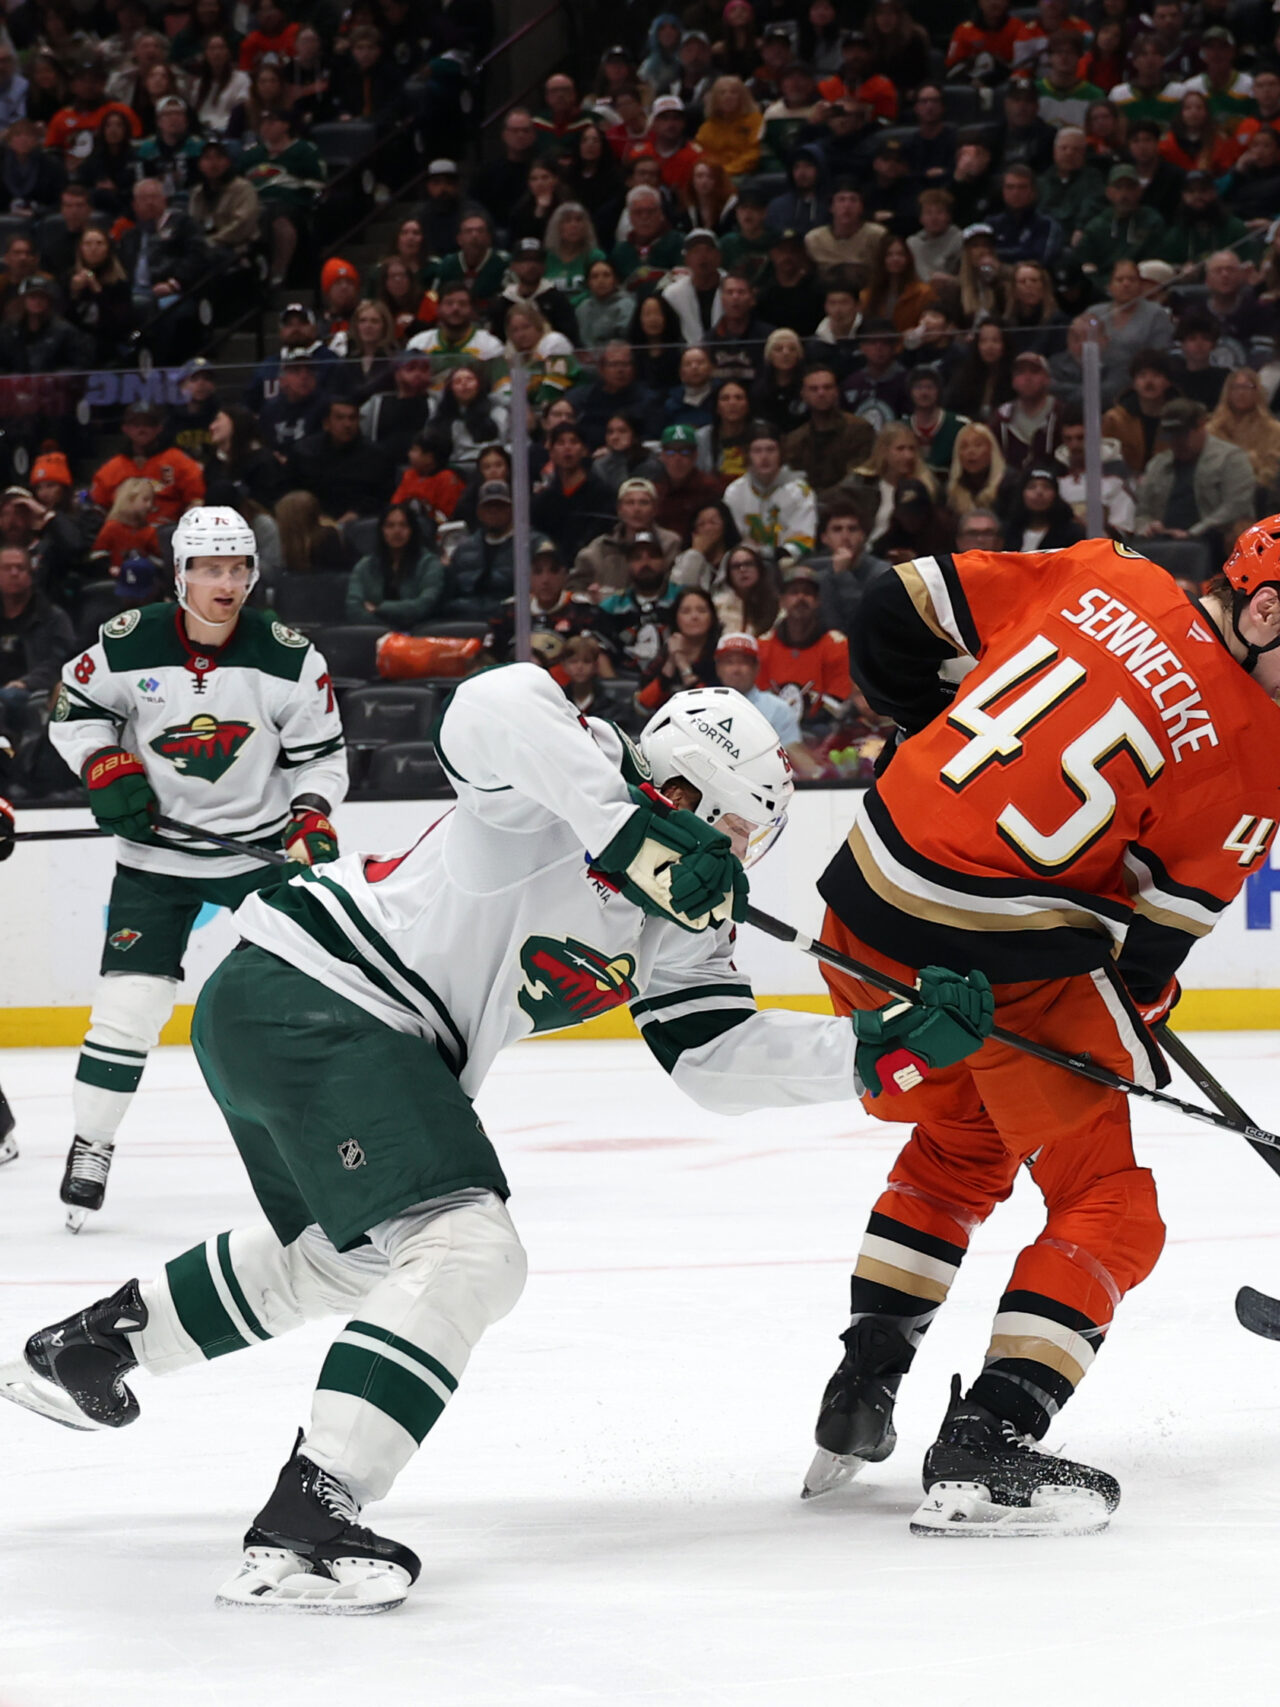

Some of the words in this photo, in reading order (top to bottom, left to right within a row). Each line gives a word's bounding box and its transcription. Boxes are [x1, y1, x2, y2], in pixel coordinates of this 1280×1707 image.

[75, 653, 96, 685] 8
[1060, 588, 1219, 764] SENNECKE
[940, 634, 1165, 877] 45
[1223, 814, 1276, 867] 4
[1246, 1126, 1275, 1143] CCM
